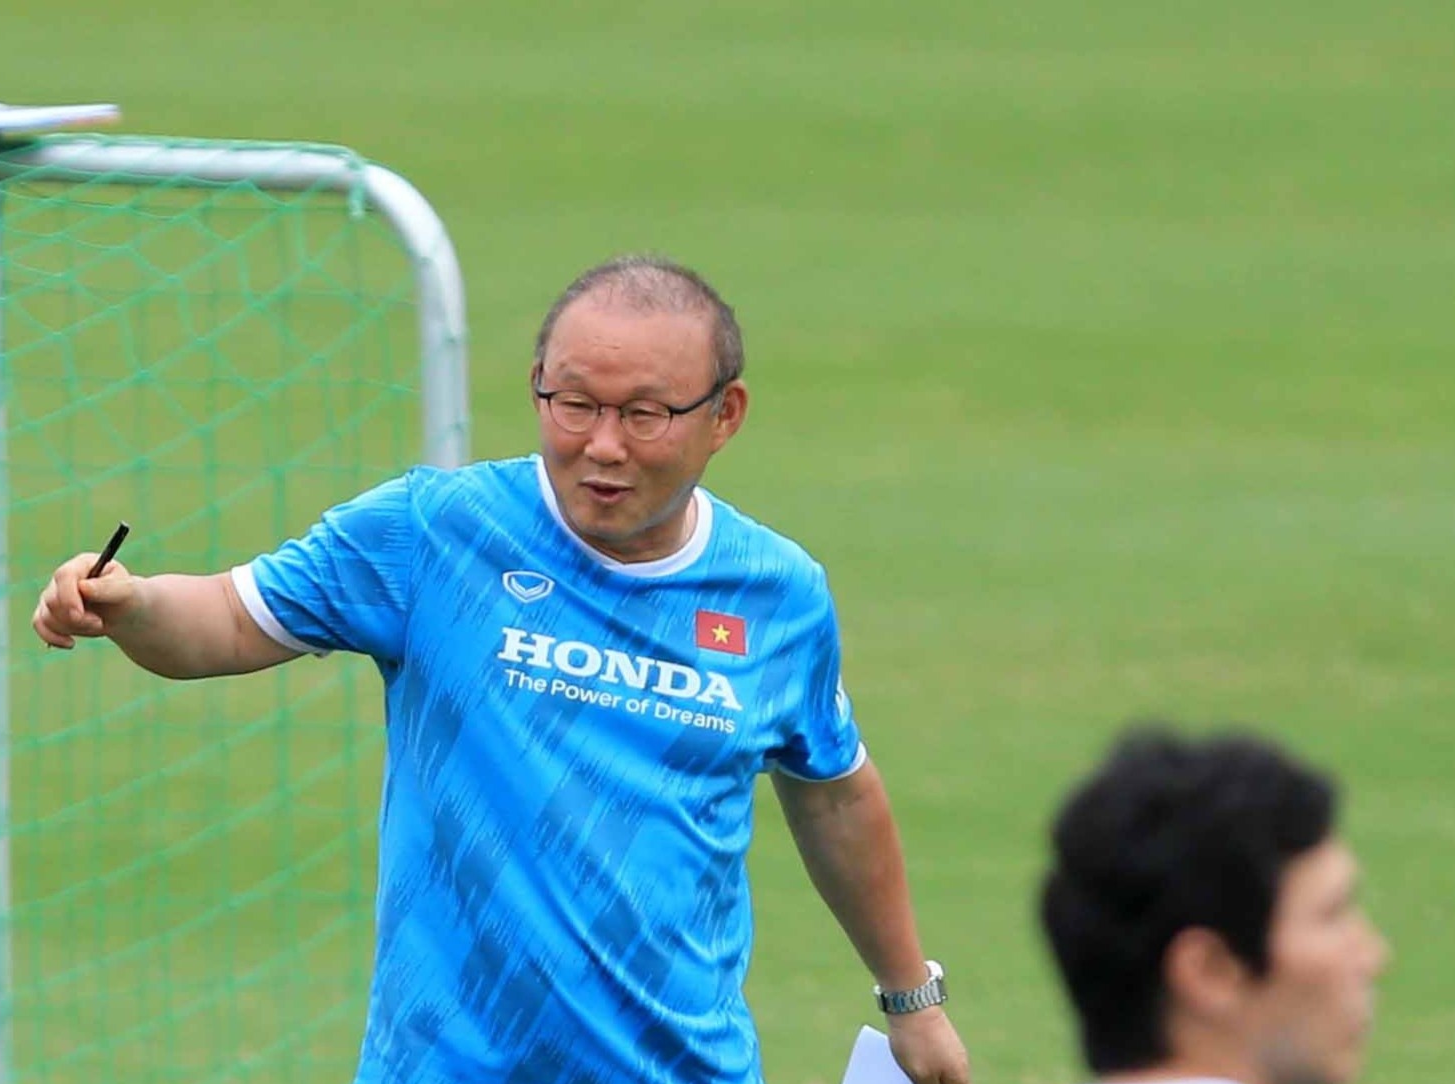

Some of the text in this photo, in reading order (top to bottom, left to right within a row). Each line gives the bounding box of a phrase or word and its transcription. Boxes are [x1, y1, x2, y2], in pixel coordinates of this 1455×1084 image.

[497, 627, 743, 711] HONDA
[505, 669, 737, 734] The Power of Dreams
